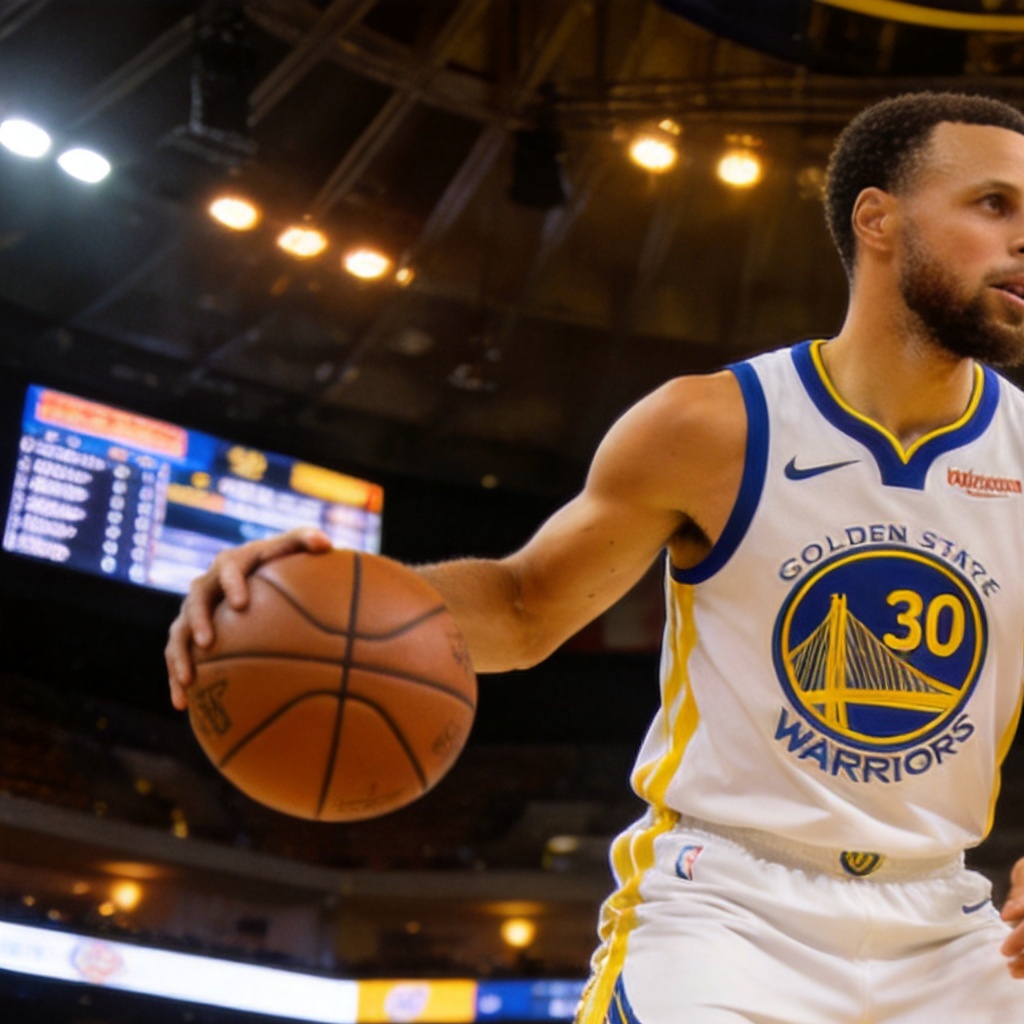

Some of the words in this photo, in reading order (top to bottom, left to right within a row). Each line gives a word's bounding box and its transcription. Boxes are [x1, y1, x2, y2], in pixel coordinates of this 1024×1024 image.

[778, 524, 908, 582] GOLDEN
[882, 589, 966, 657] 30
[774, 706, 975, 783] WARRIORS
